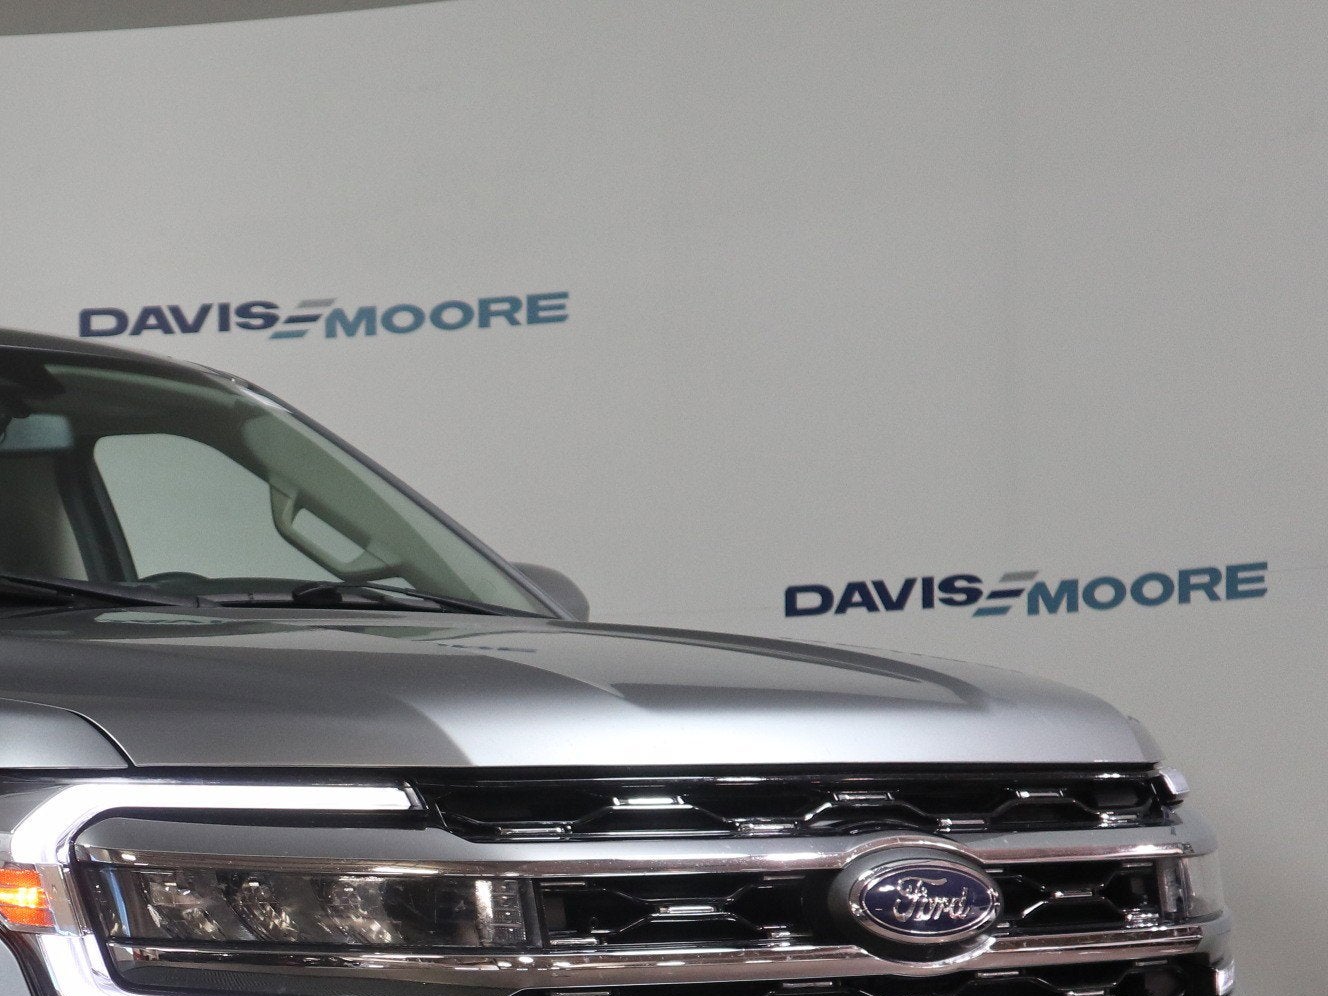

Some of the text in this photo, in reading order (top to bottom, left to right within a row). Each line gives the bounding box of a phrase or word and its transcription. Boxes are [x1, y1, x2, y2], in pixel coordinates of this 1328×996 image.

[78, 290, 570, 340] DAVIS MOORE
[784, 561, 1269, 618] DAVIS MOORE
[892, 876, 972, 923] Ford
